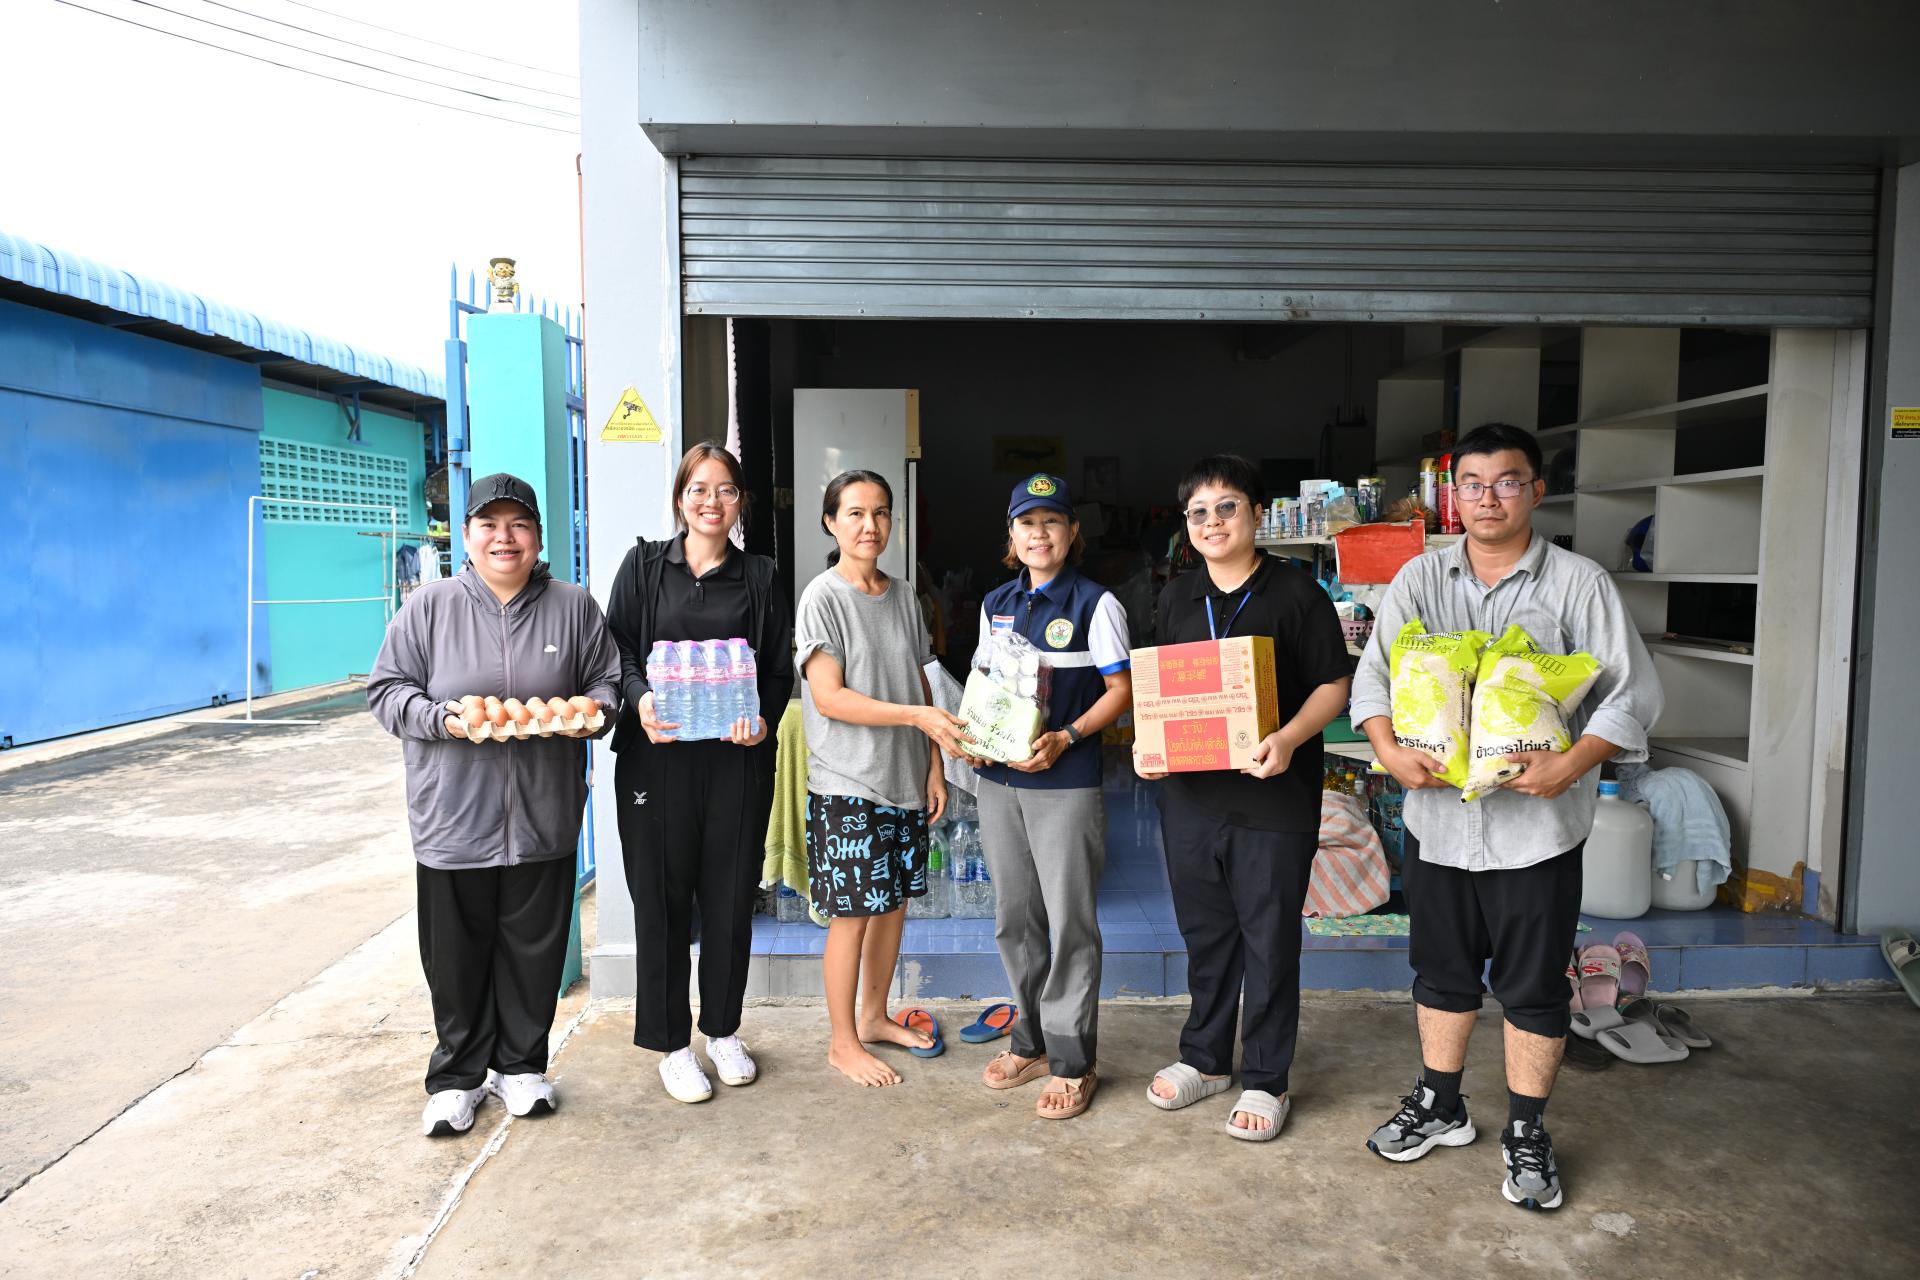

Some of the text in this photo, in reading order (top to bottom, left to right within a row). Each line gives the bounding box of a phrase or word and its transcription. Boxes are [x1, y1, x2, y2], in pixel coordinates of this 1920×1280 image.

[1476, 739, 1551, 758] ข้าวตราไก่แจ้
